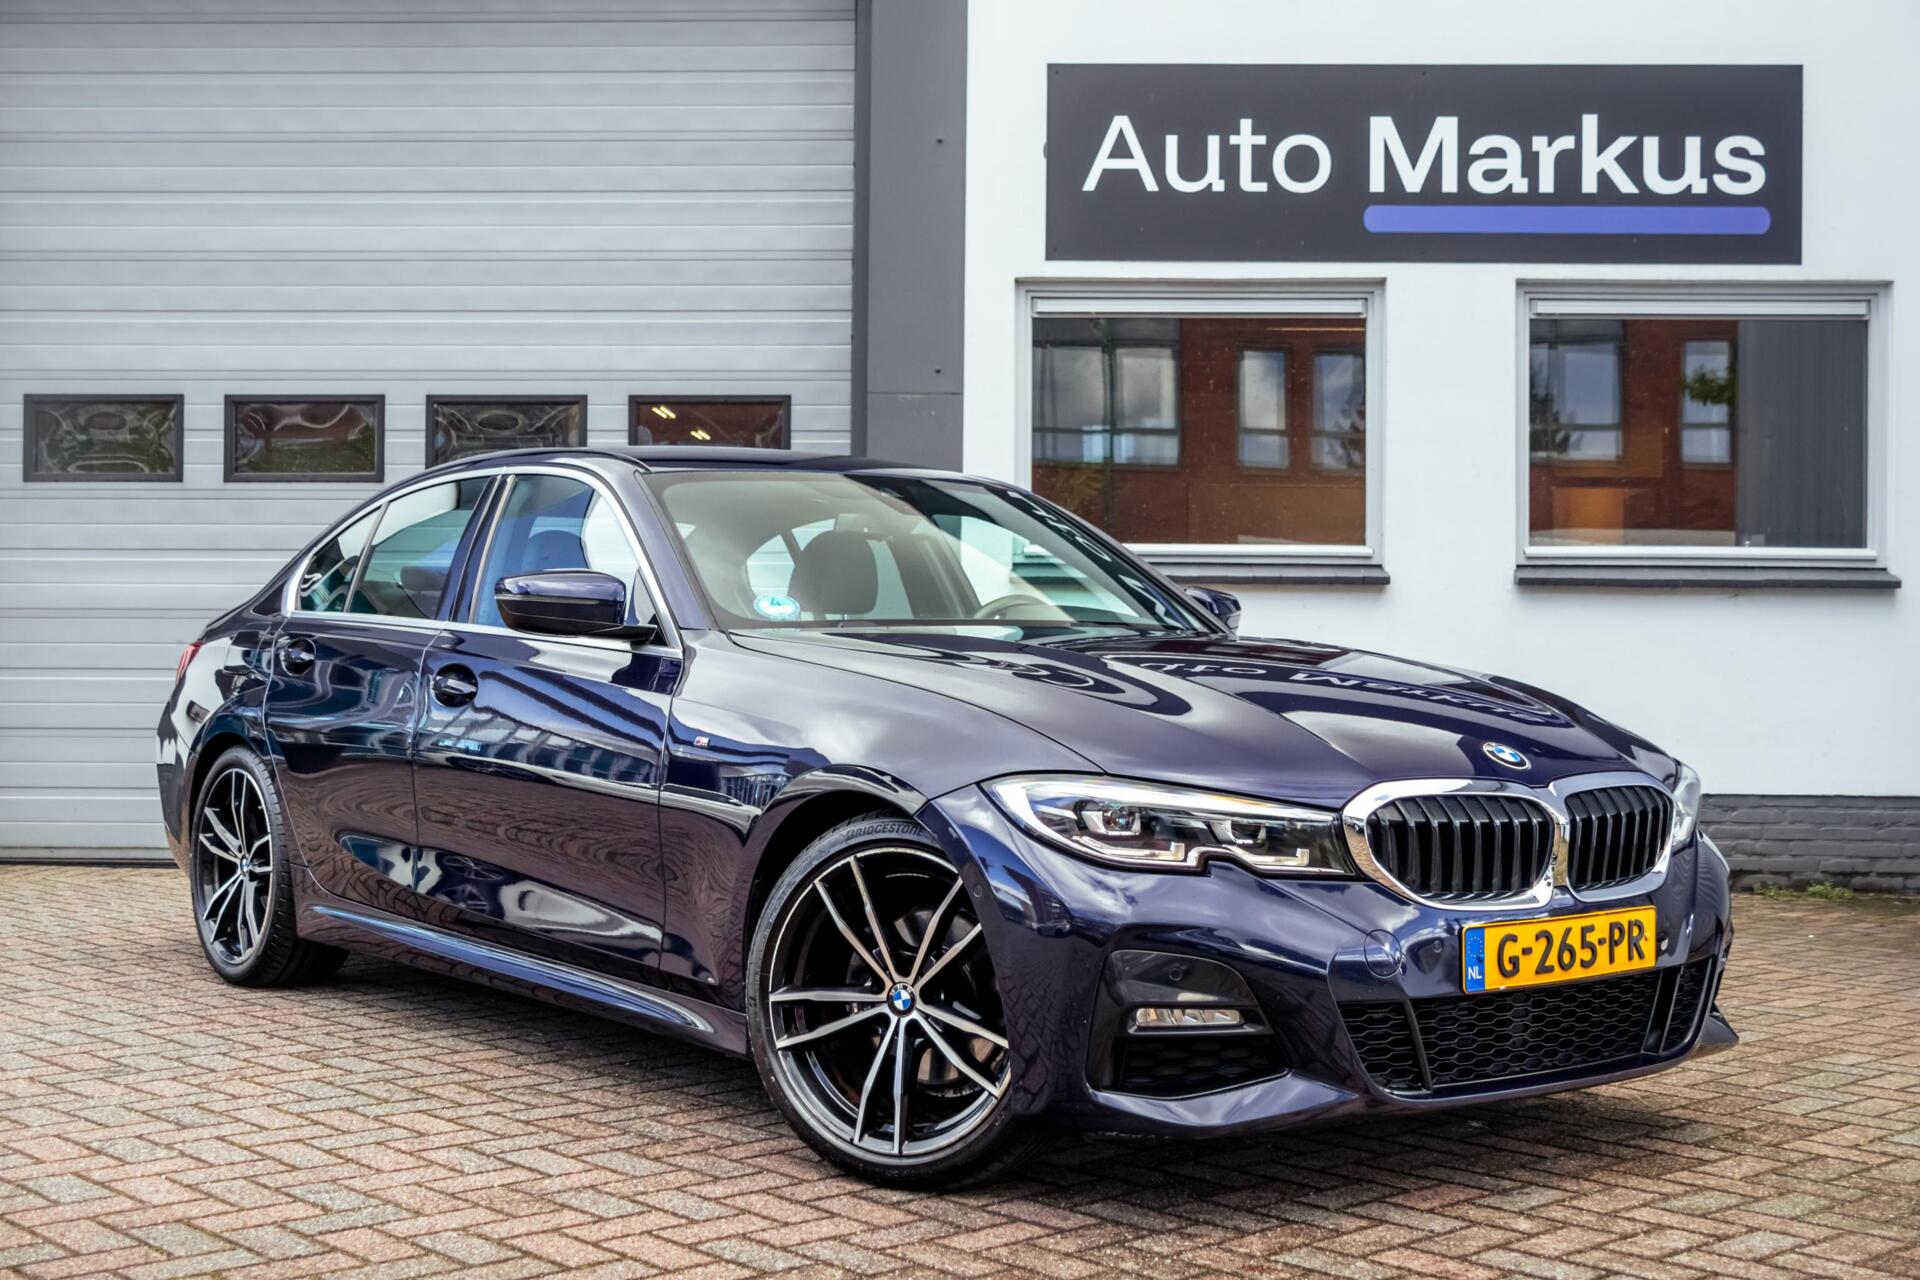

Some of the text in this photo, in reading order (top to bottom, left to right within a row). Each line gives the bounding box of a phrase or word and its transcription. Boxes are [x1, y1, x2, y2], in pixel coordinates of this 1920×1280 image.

[1081, 113, 1767, 195] Auto Markus
[1467, 965, 1483, 980] NL
[1497, 918, 1646, 979] G-265-PR
